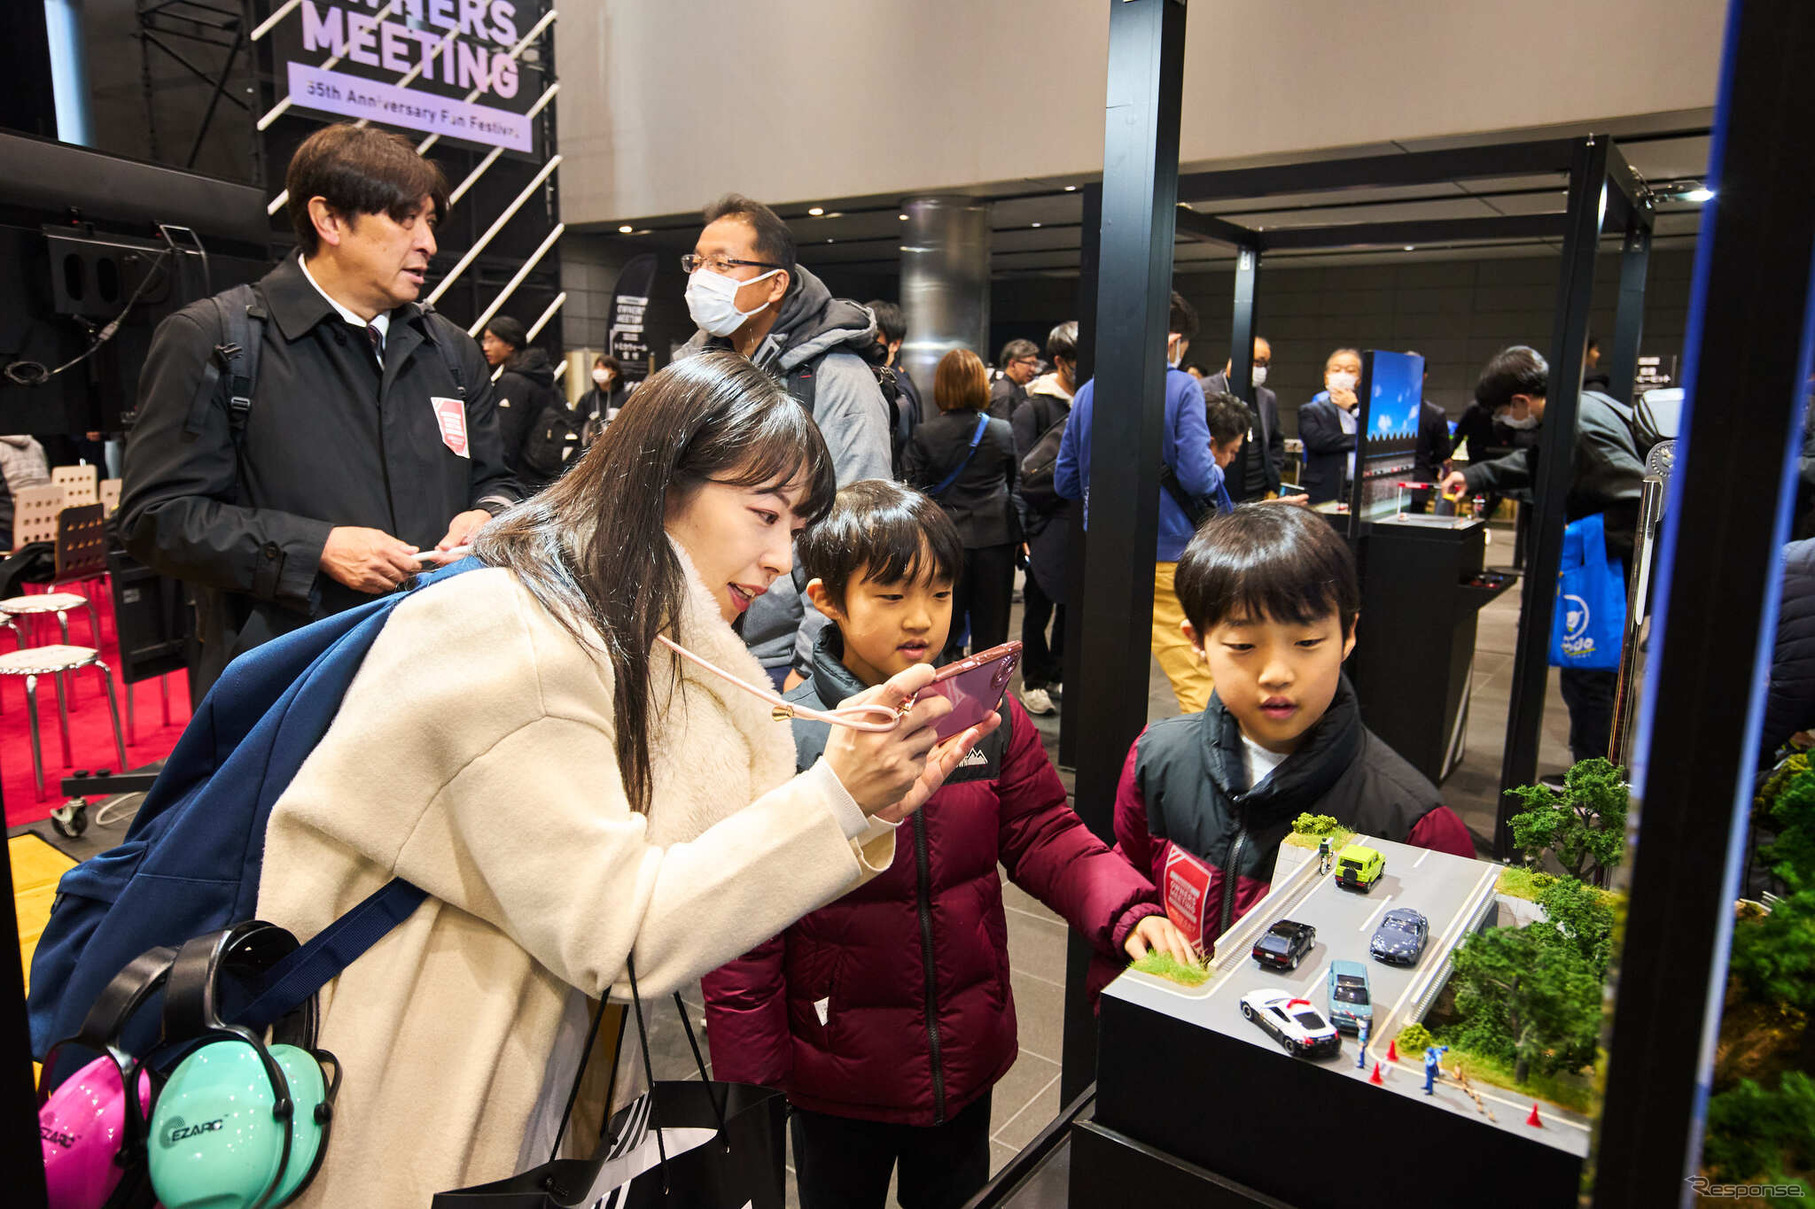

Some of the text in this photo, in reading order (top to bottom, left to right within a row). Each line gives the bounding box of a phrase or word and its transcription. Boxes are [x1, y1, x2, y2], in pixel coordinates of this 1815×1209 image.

[352, 0, 516, 46] ERS
[302, 0, 519, 98] MEETING
[40, 1126, 75, 1149] ZARC
[172, 1119, 223, 1142] EZARC
